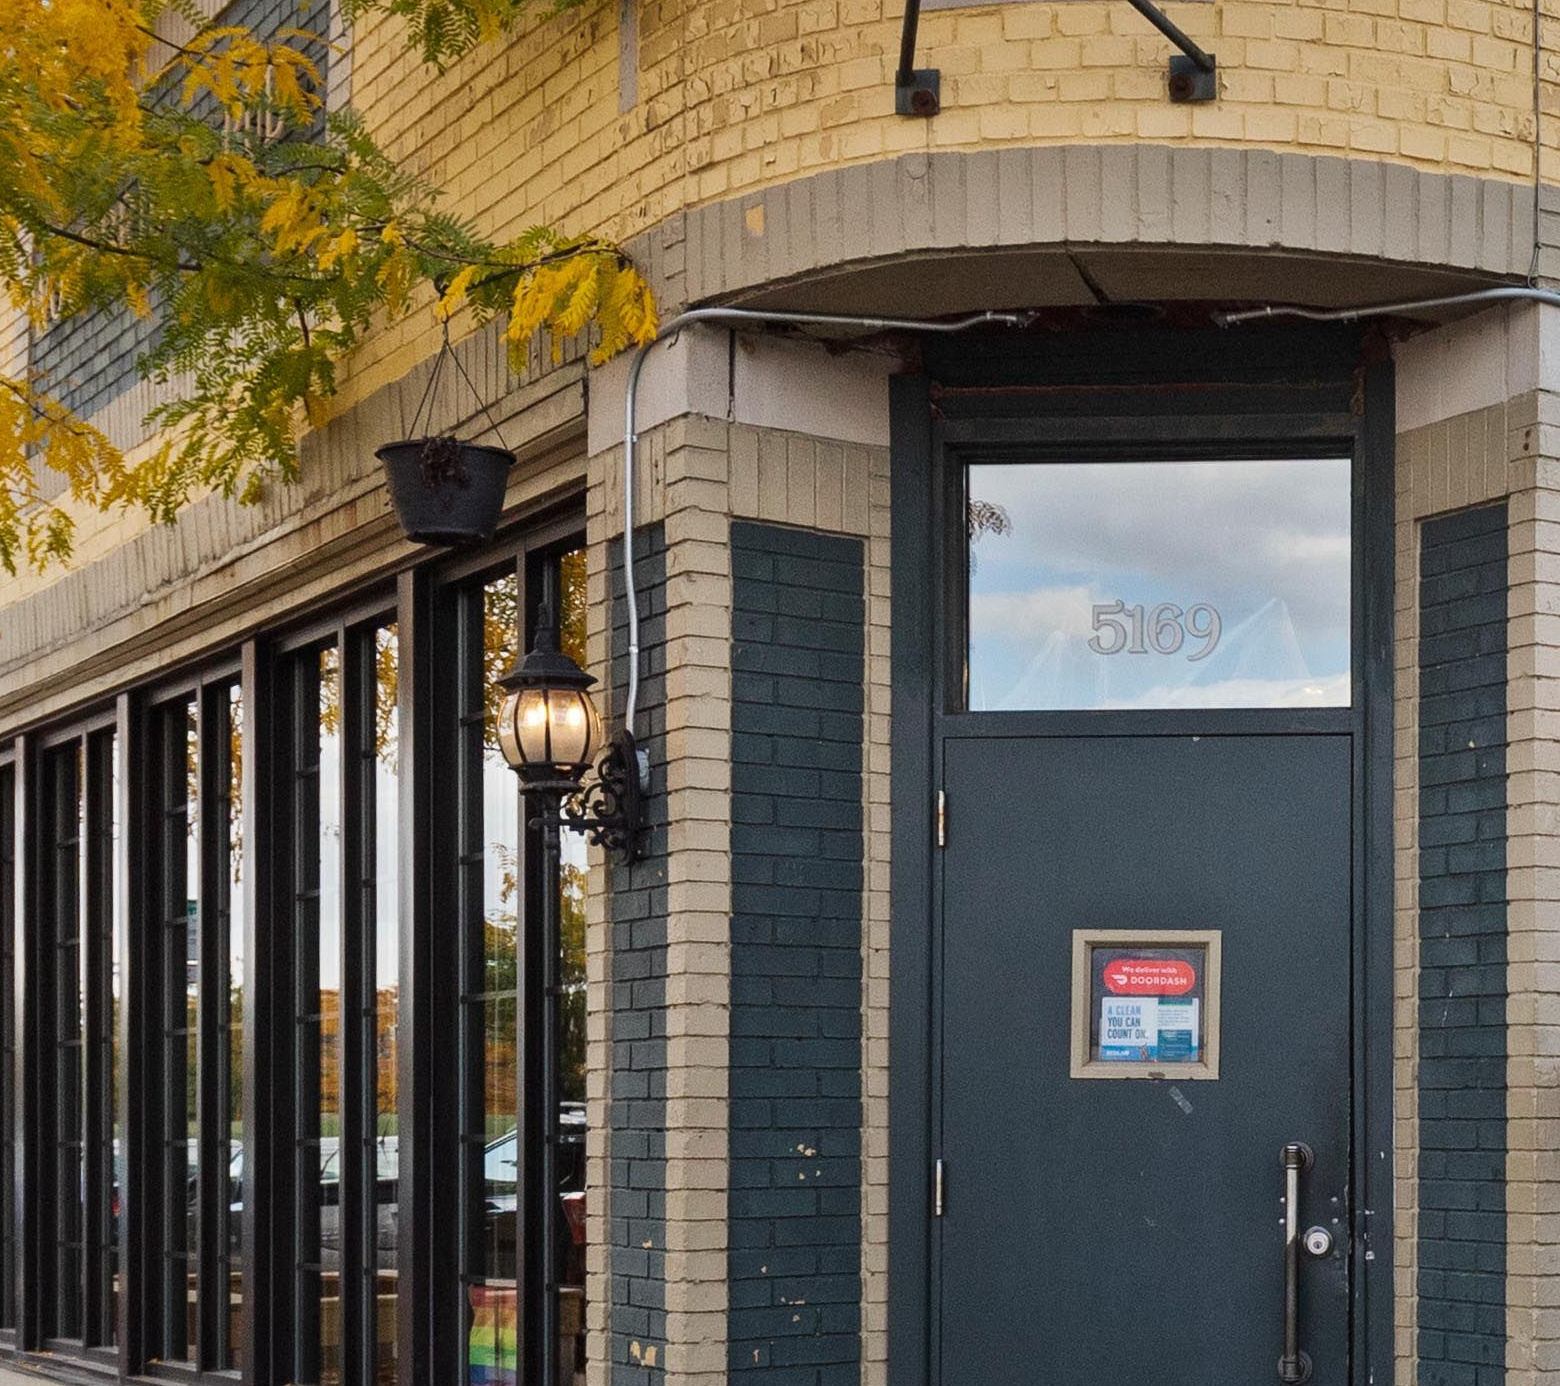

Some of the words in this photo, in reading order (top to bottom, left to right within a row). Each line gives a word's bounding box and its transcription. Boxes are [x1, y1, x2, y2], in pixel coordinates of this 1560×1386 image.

[1087, 598, 1223, 662] 5169
[1130, 976, 1187, 986] DOORDASH
[1107, 1016, 1123, 1027] YOU
[1125, 1016, 1141, 1027] CAN
[1107, 1028, 1133, 1039] COUNT
